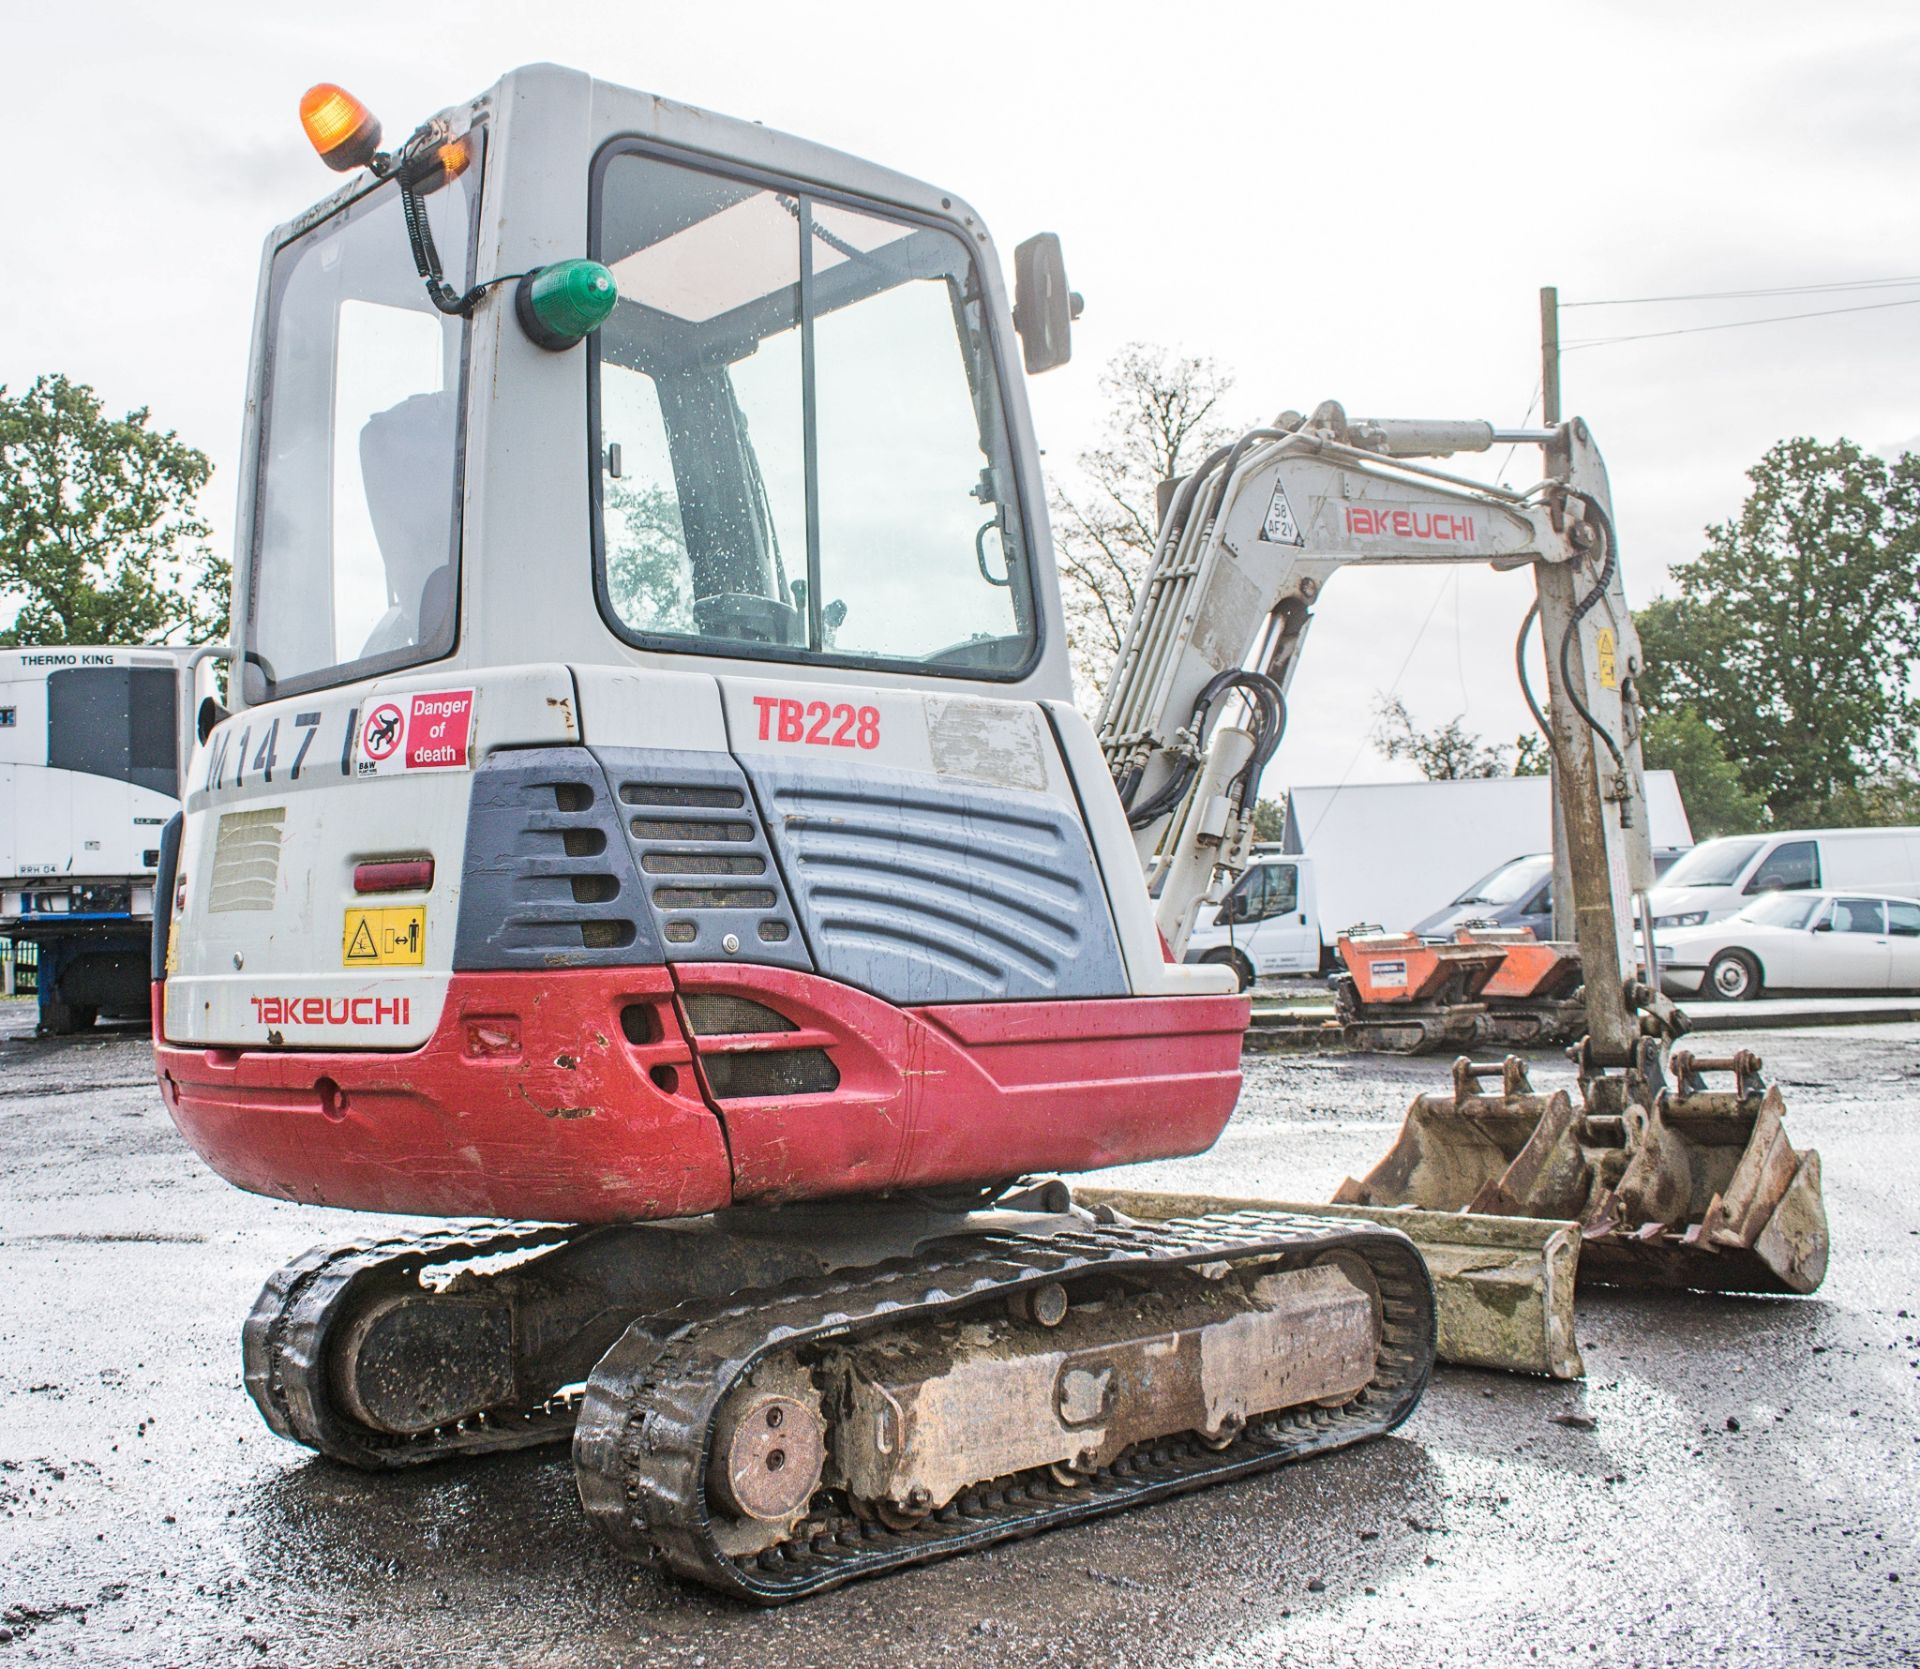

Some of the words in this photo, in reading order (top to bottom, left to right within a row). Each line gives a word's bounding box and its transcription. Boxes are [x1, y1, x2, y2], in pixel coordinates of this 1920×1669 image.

[1274, 503, 1287, 519] 58
[20, 655, 77, 666] THERMO
[82, 655, 114, 665] KING
[414, 700, 469, 718] Danger
[429, 722, 447, 738] of
[753, 696, 881, 750] TB228
[414, 745, 456, 763] death
[358, 761, 376, 770] B&W
